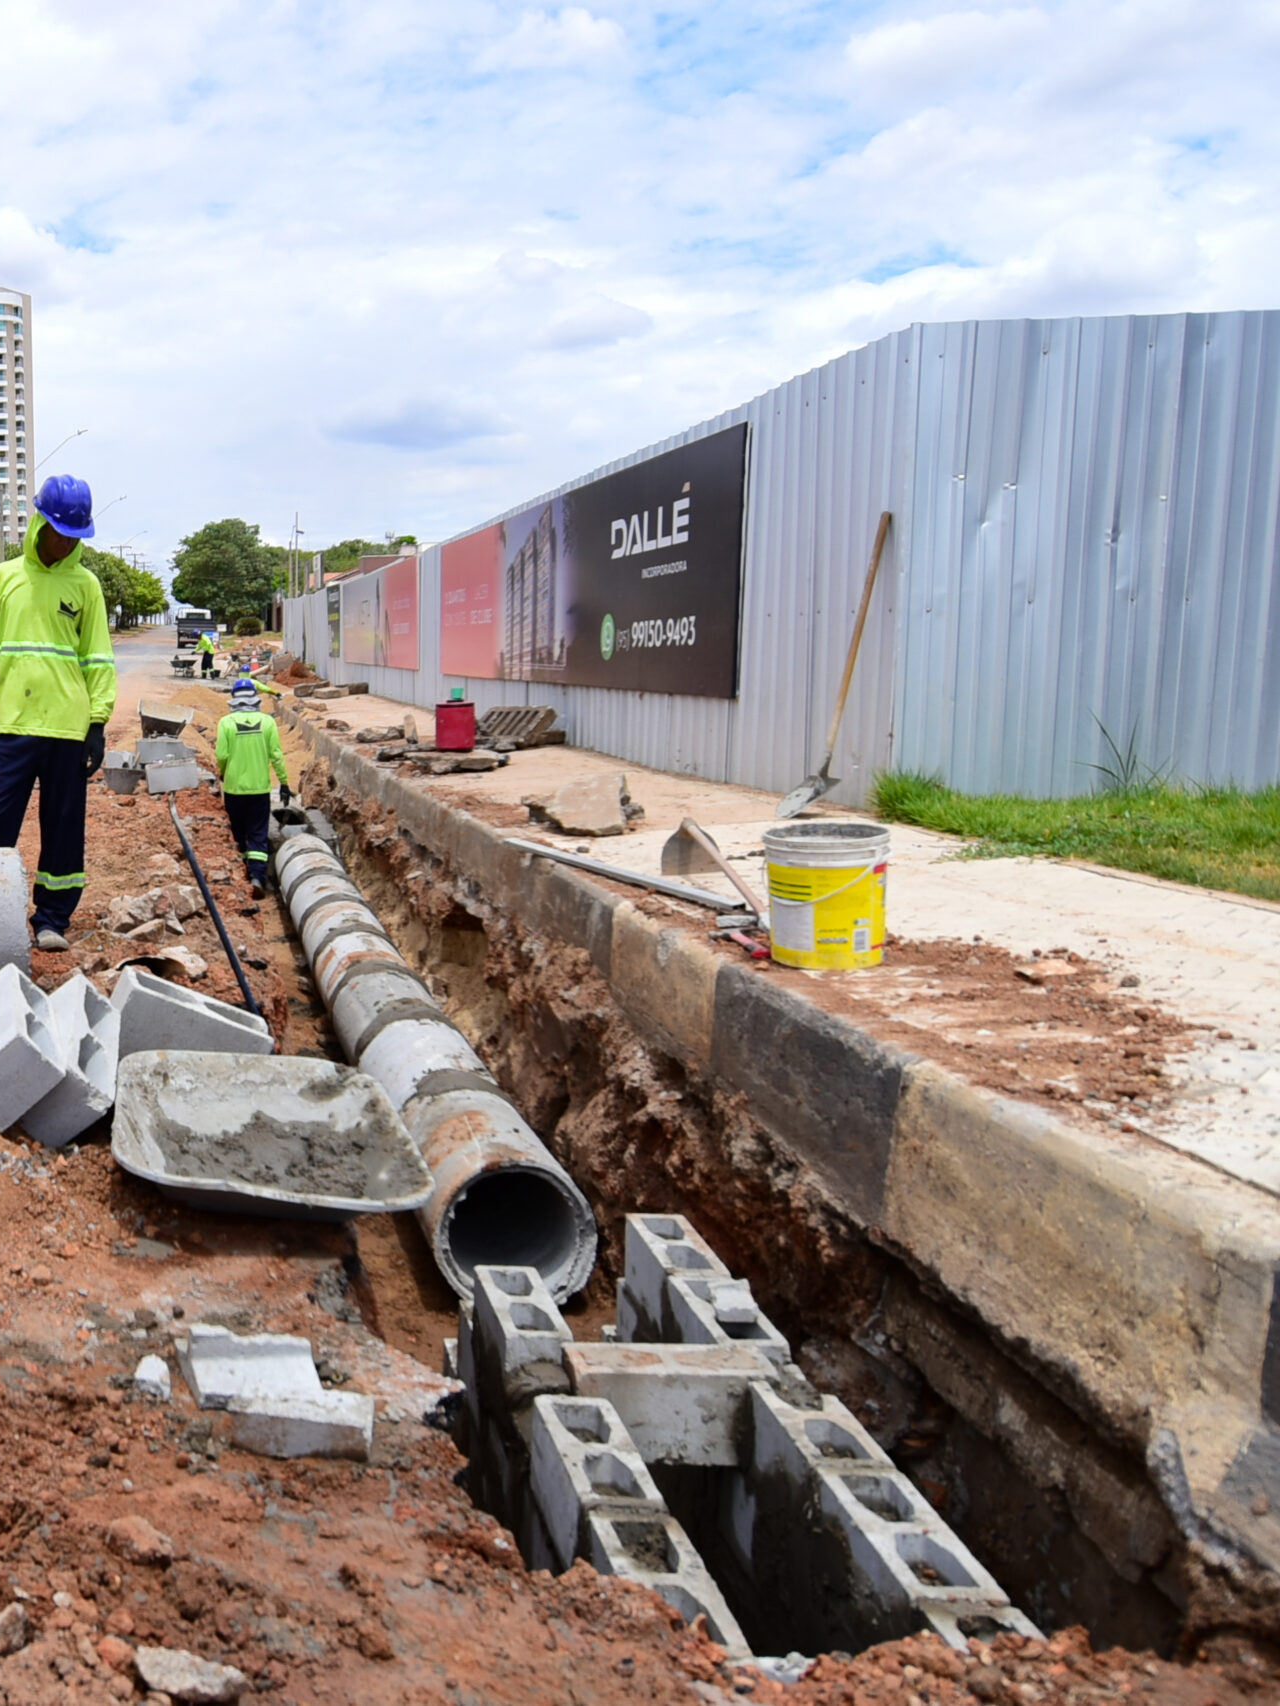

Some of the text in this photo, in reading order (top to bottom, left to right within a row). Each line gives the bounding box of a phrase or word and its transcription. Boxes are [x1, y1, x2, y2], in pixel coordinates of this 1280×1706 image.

[611, 481, 690, 559] DALLÉ
[641, 560, 688, 579] INCORPORADORA
[631, 615, 696, 648] 99150-9493
